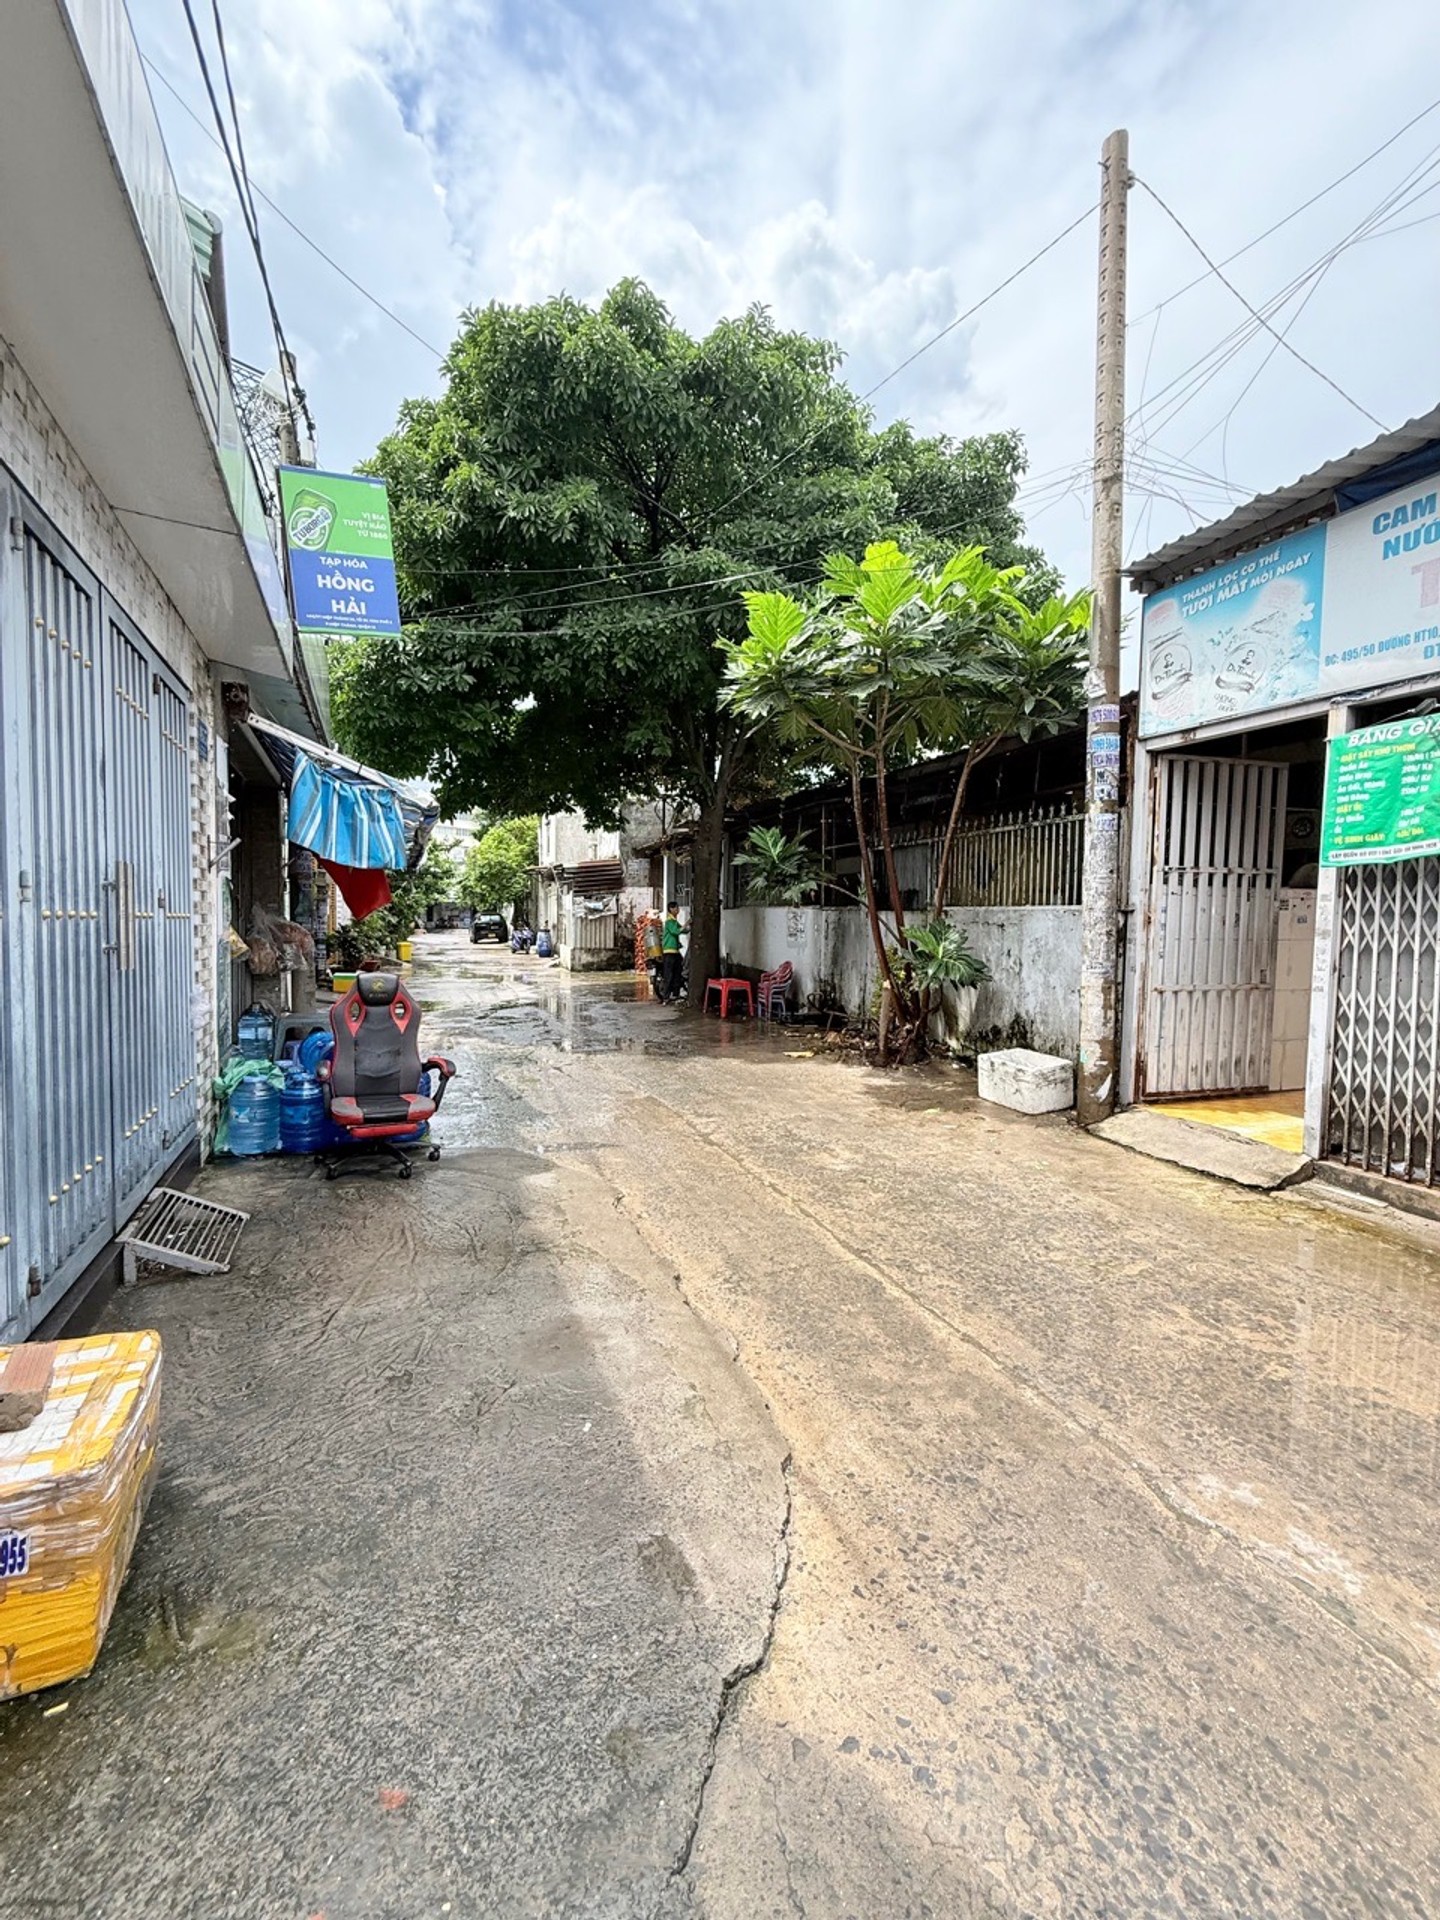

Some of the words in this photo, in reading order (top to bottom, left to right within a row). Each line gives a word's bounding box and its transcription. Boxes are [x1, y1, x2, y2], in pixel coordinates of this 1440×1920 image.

[292, 508, 331, 542] TUBORG
[1372, 492, 1437, 535] CAM
[319, 556, 341, 569] TẠP
[343, 557, 368, 570] HÓA
[317, 570, 375, 593] HỒNG
[1182, 580, 1216, 603] THANH
[1218, 571, 1239, 588] LỌC
[1241, 562, 1257, 576] CƠ
[331, 596, 366, 615] HẢI
[1182, 594, 1213, 618] TƯƠI
[1217, 579, 1248, 604] MÁT
[1341, 643, 1375, 662] 495/50
[1347, 725, 1403, 748] BẢNG
